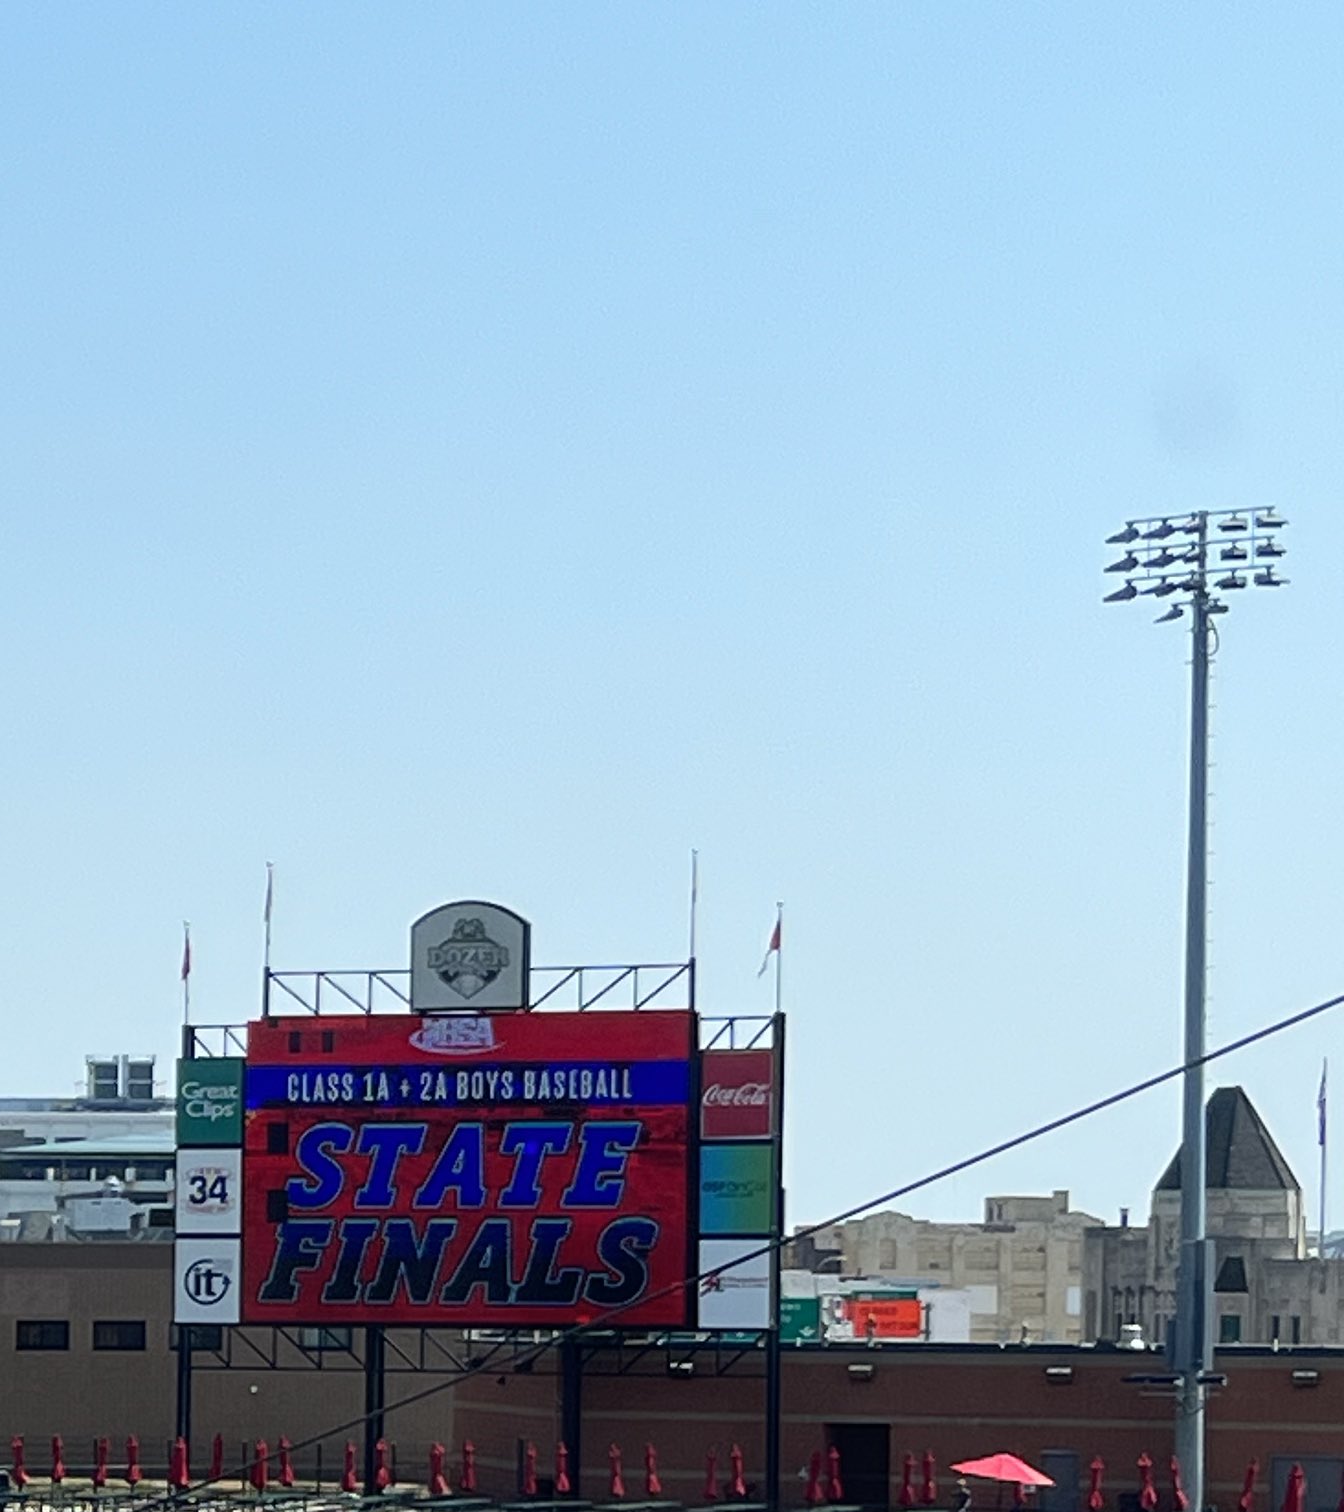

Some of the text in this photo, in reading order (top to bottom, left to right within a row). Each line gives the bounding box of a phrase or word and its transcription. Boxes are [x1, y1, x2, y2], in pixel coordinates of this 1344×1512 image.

[181, 1081, 238, 1100] Great
[287, 1072, 353, 1102] CLASS
[362, 1072, 390, 1101] 1A
[420, 1071, 447, 1101] 2A
[456, 1070, 513, 1101] BOYS
[523, 1068, 633, 1100] BASEBALL
[185, 1101, 236, 1122] Clips
[287, 1122, 642, 1210] STATE
[188, 1175, 229, 1205] 34
[260, 1218, 658, 1304] FINALS
